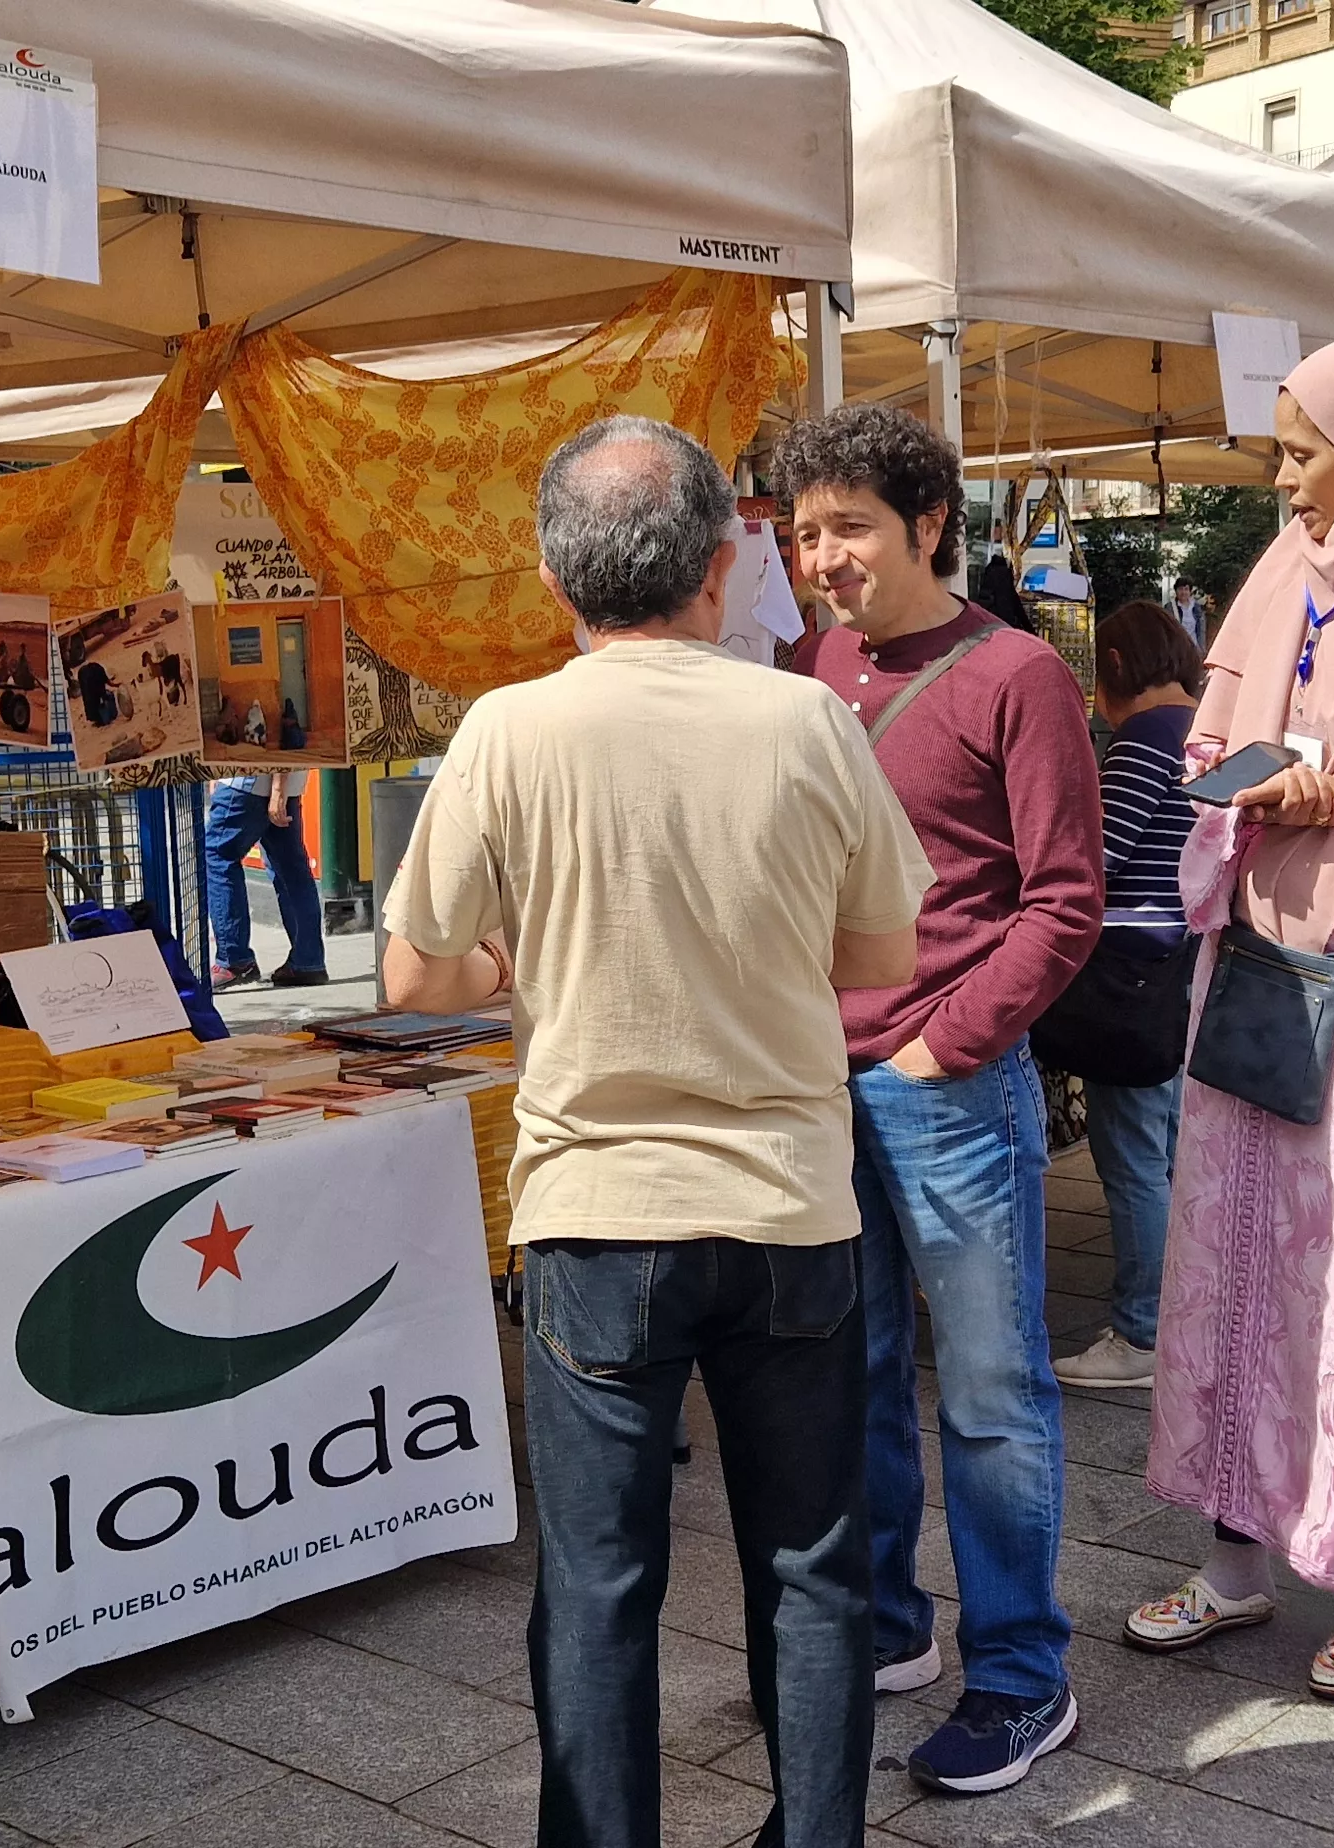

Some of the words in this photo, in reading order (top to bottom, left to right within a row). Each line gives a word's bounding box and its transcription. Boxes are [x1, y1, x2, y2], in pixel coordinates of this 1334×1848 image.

[679, 236, 781, 264] MASTERTENT
[216, 538, 273, 553] CUANDO
[352, 707, 374, 719] QUE
[10, 1633, 39, 1658] OS
[46, 1614, 85, 1644] DEL
[92, 1583, 185, 1625] PUEBLO
[193, 1546, 299, 1594] SAHARAUI
[305, 1534, 344, 1558] DEL
[350, 1516, 399, 1545] ALTO
[402, 1492, 494, 1528] ARAGÓN
